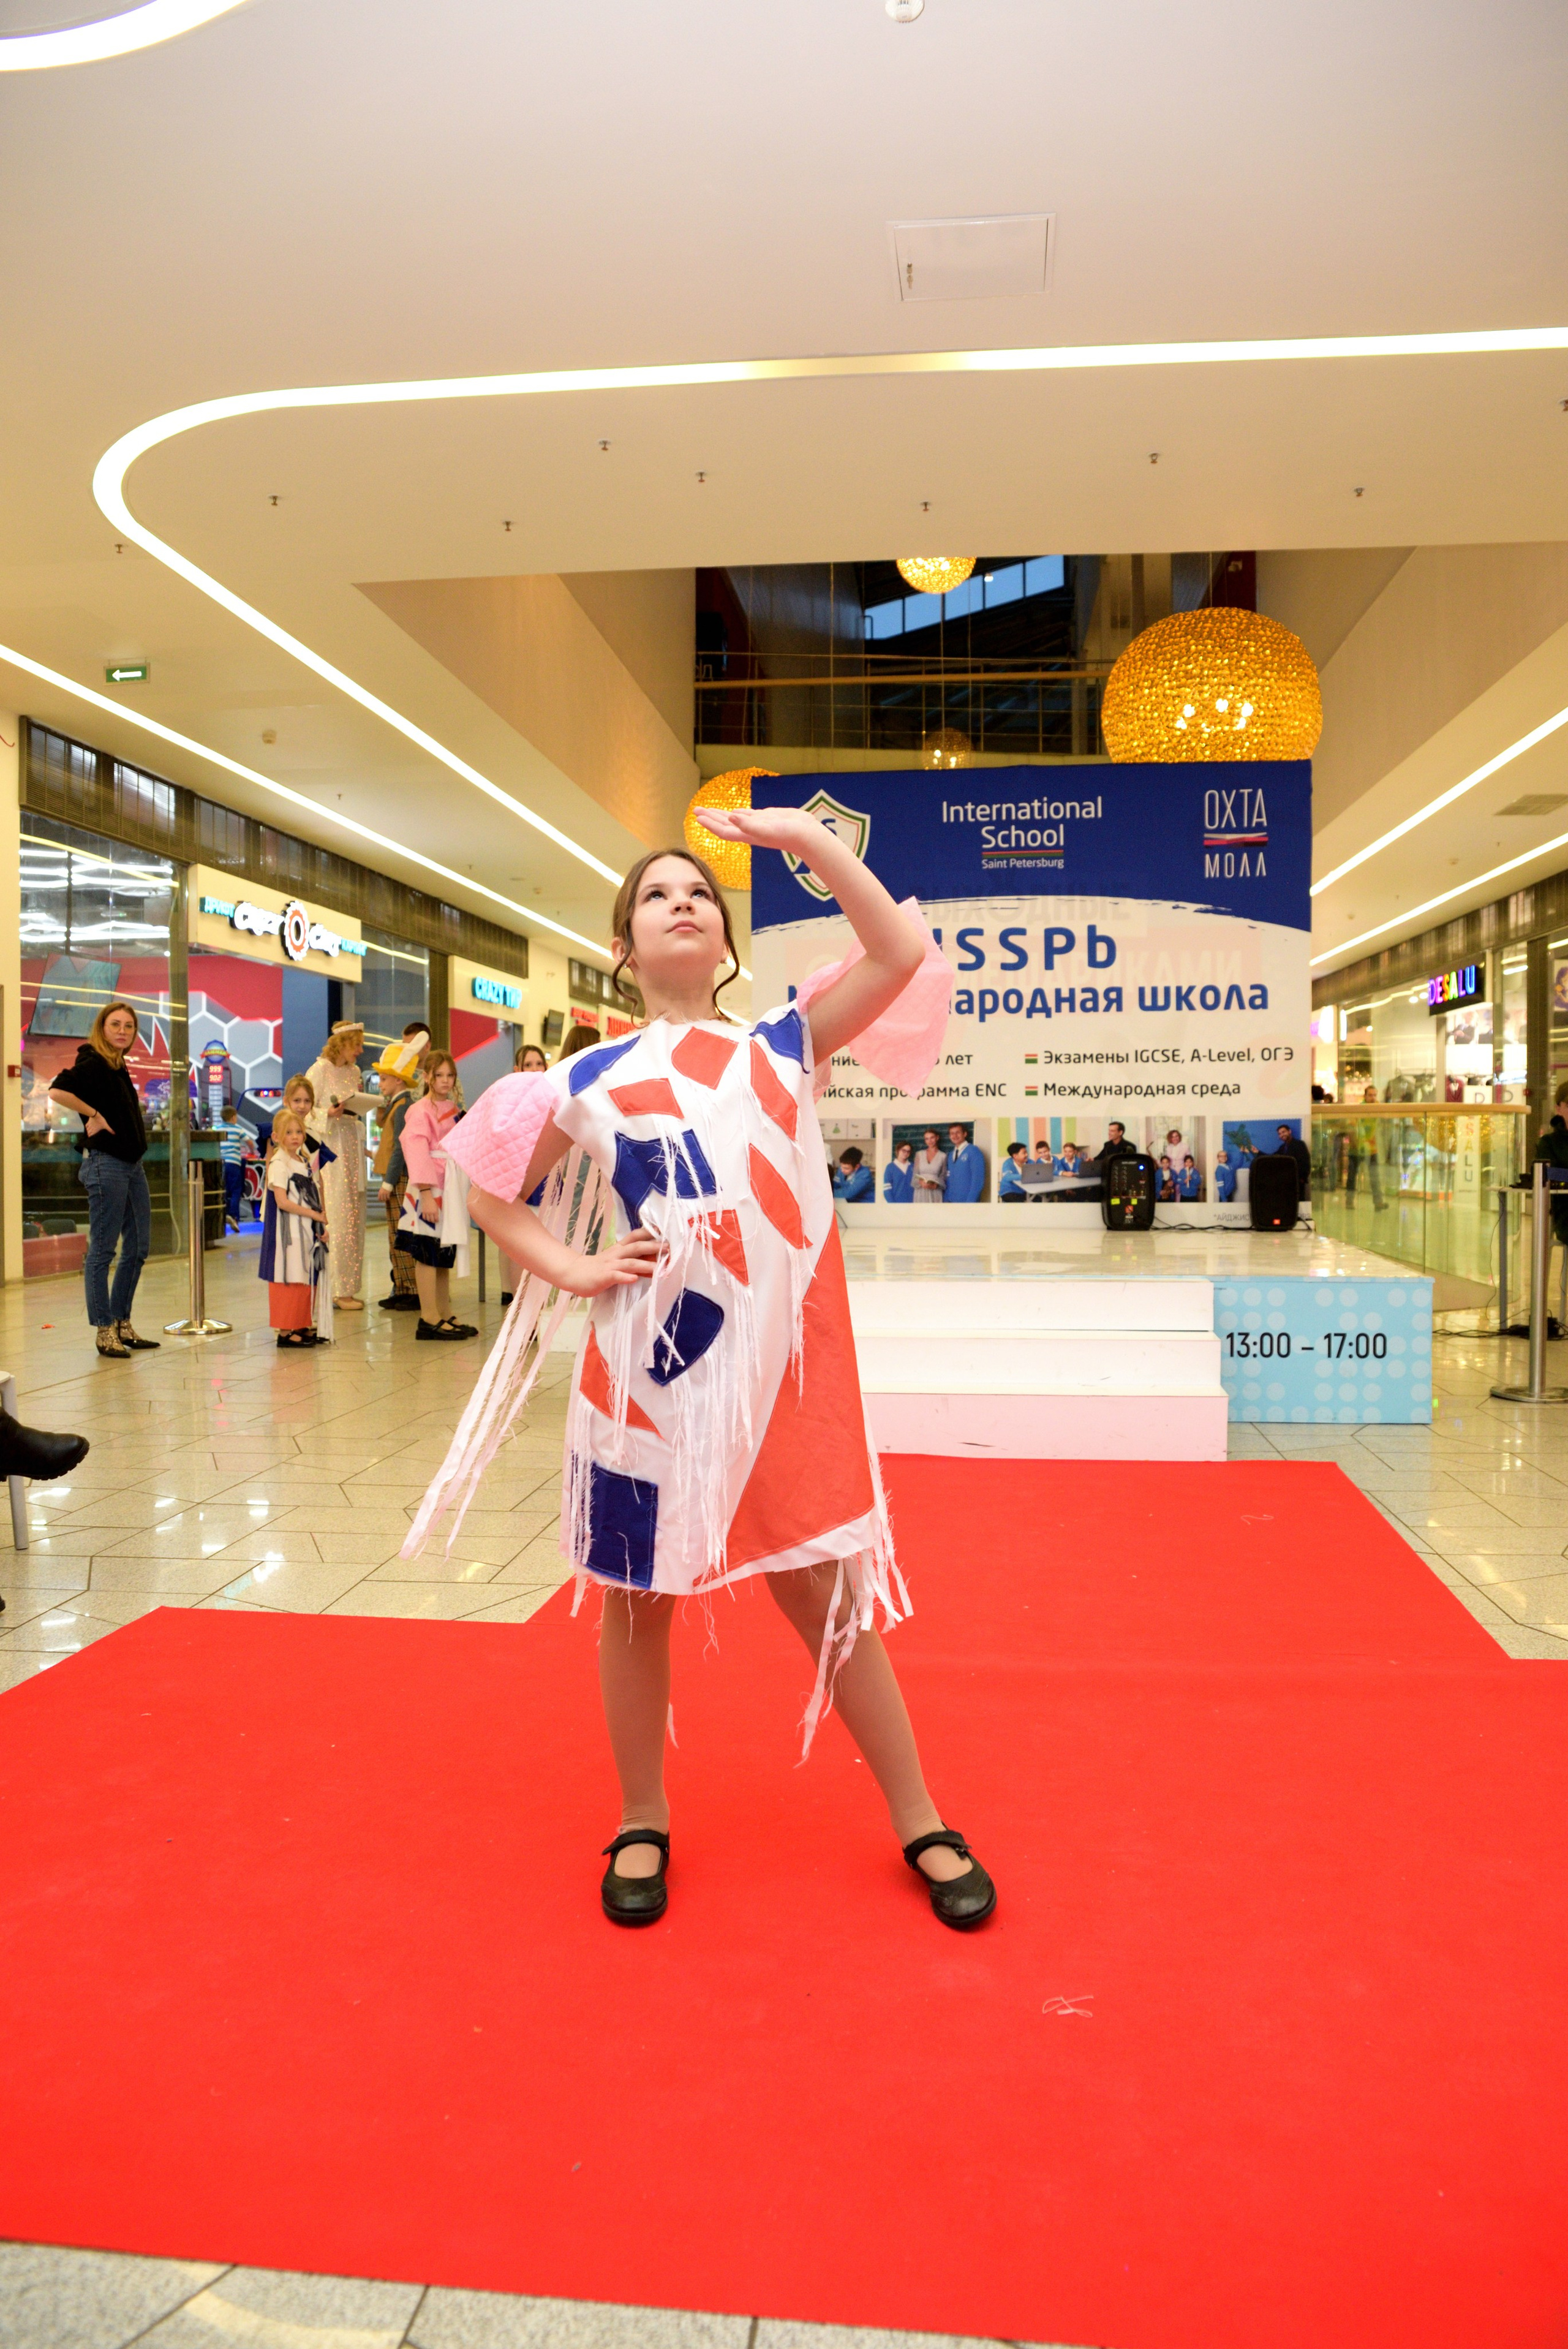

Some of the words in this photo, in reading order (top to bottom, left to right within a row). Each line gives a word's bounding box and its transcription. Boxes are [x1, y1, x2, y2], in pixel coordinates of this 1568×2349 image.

[943, 796, 1102, 823] International
[1205, 788, 1267, 828] ОХТА
[981, 824, 1064, 849] School
[982, 858, 1008, 869] Saint
[1009, 857, 1065, 869] Petersburg
[1205, 852, 1267, 878] МОЛЛ
[475, 976, 505, 1005] CRAZY
[1428, 964, 1476, 1006] DESALU
[949, 986, 1123, 1023] ародная
[1138, 983, 1268, 1012] школа
[945, 1054, 973, 1065] лет
[1044, 1050, 1129, 1064] Экзамены
[1135, 1049, 1185, 1064] IGCSE,
[1190, 1048, 1254, 1063] A-Level,
[1261, 1047, 1294, 1061] ОГЭ
[824, 1084, 874, 1098] йская
[880, 1086, 970, 1100] прорамма
[975, 1083, 1006, 1097] ENC
[1044, 1083, 1186, 1099] Международная
[1191, 1084, 1240, 1098] среда
[1226, 1332, 1291, 1358] 13:00
[1324, 1333, 1387, 1359] 17:00
